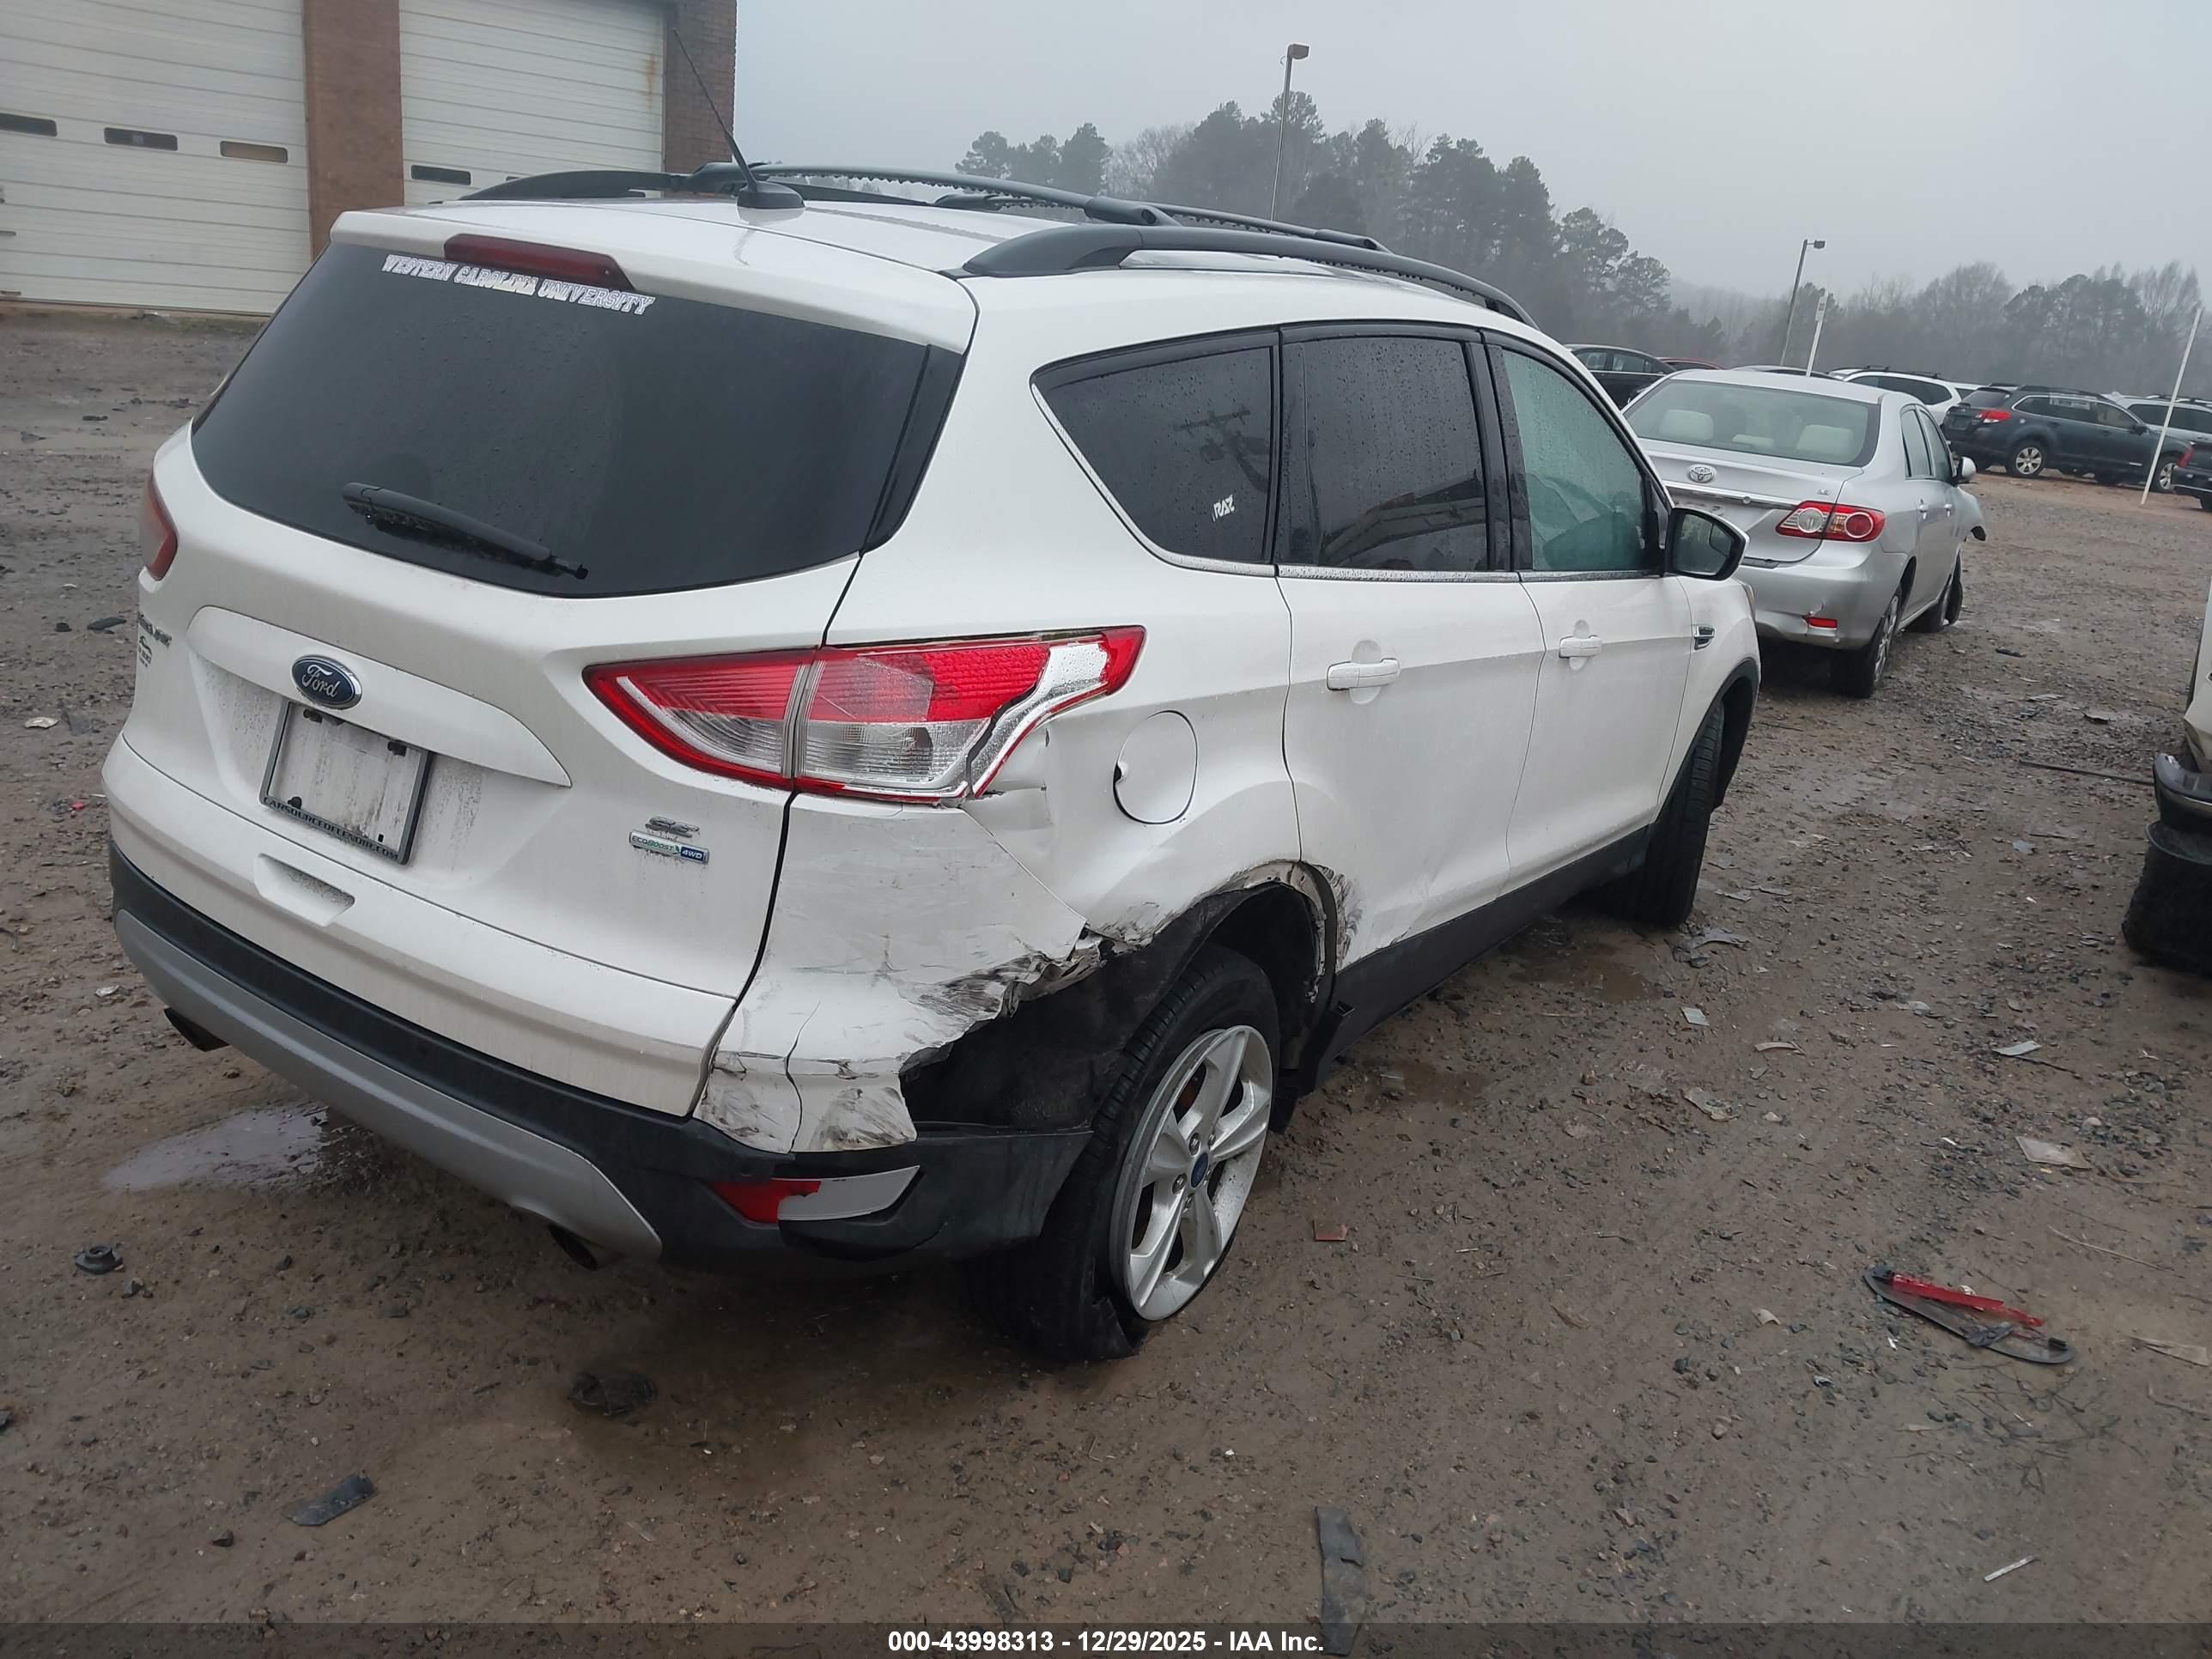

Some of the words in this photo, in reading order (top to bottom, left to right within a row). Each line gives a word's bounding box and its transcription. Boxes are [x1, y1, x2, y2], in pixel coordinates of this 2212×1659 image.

[381, 254, 456, 282] WESTERN
[453, 266, 538, 296] CAROLINA
[538, 279, 656, 315] UNIVERSITY
[301, 665, 341, 698] Ford
[682, 848, 703, 860] 4WD
